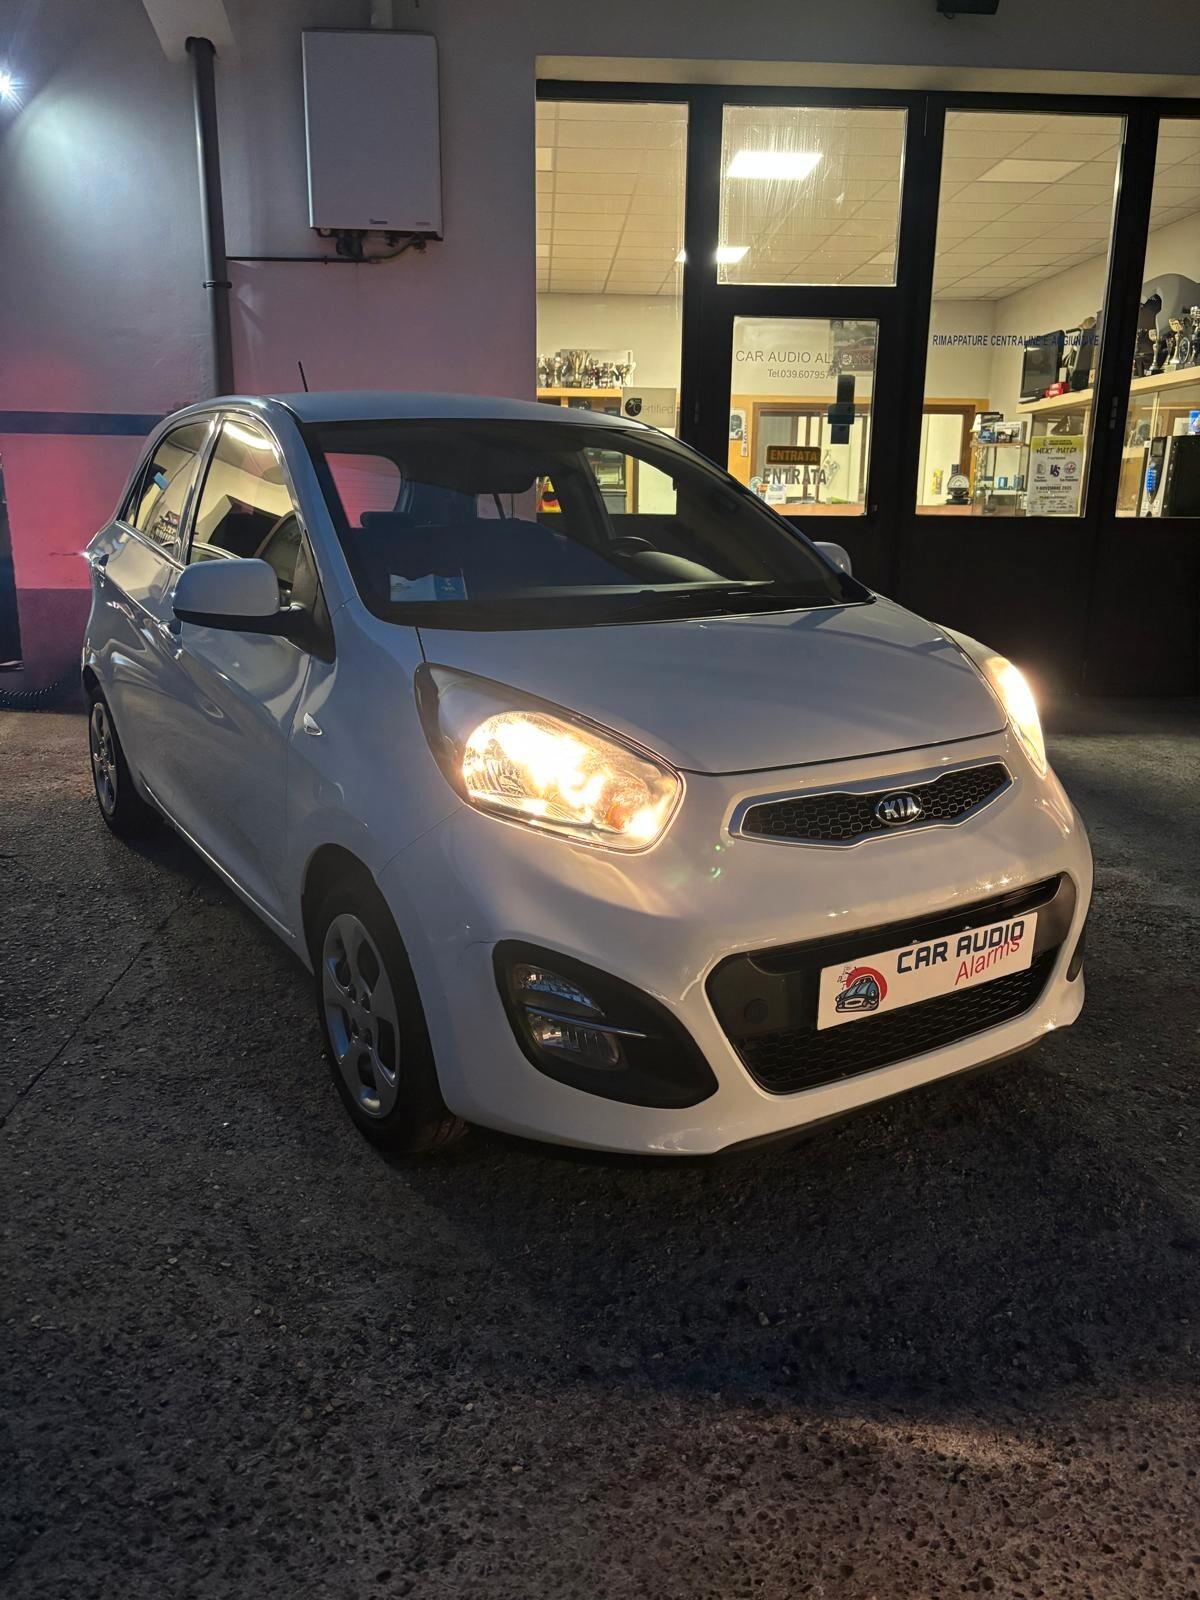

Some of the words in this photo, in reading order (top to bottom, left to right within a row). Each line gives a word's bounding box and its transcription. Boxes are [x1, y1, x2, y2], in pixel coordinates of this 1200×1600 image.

[932, 334, 988, 346] RIMAPPATURE
[735, 350, 764, 362] CAR
[768, 351, 811, 364] AUDIO
[770, 449, 818, 462] ENTRATA
[762, 467, 827, 486] ENTRATA
[883, 796, 920, 820] KIA
[896, 941, 948, 974] CAR
[956, 920, 1025, 957] AUDIO
[954, 935, 1022, 986] Alarms
